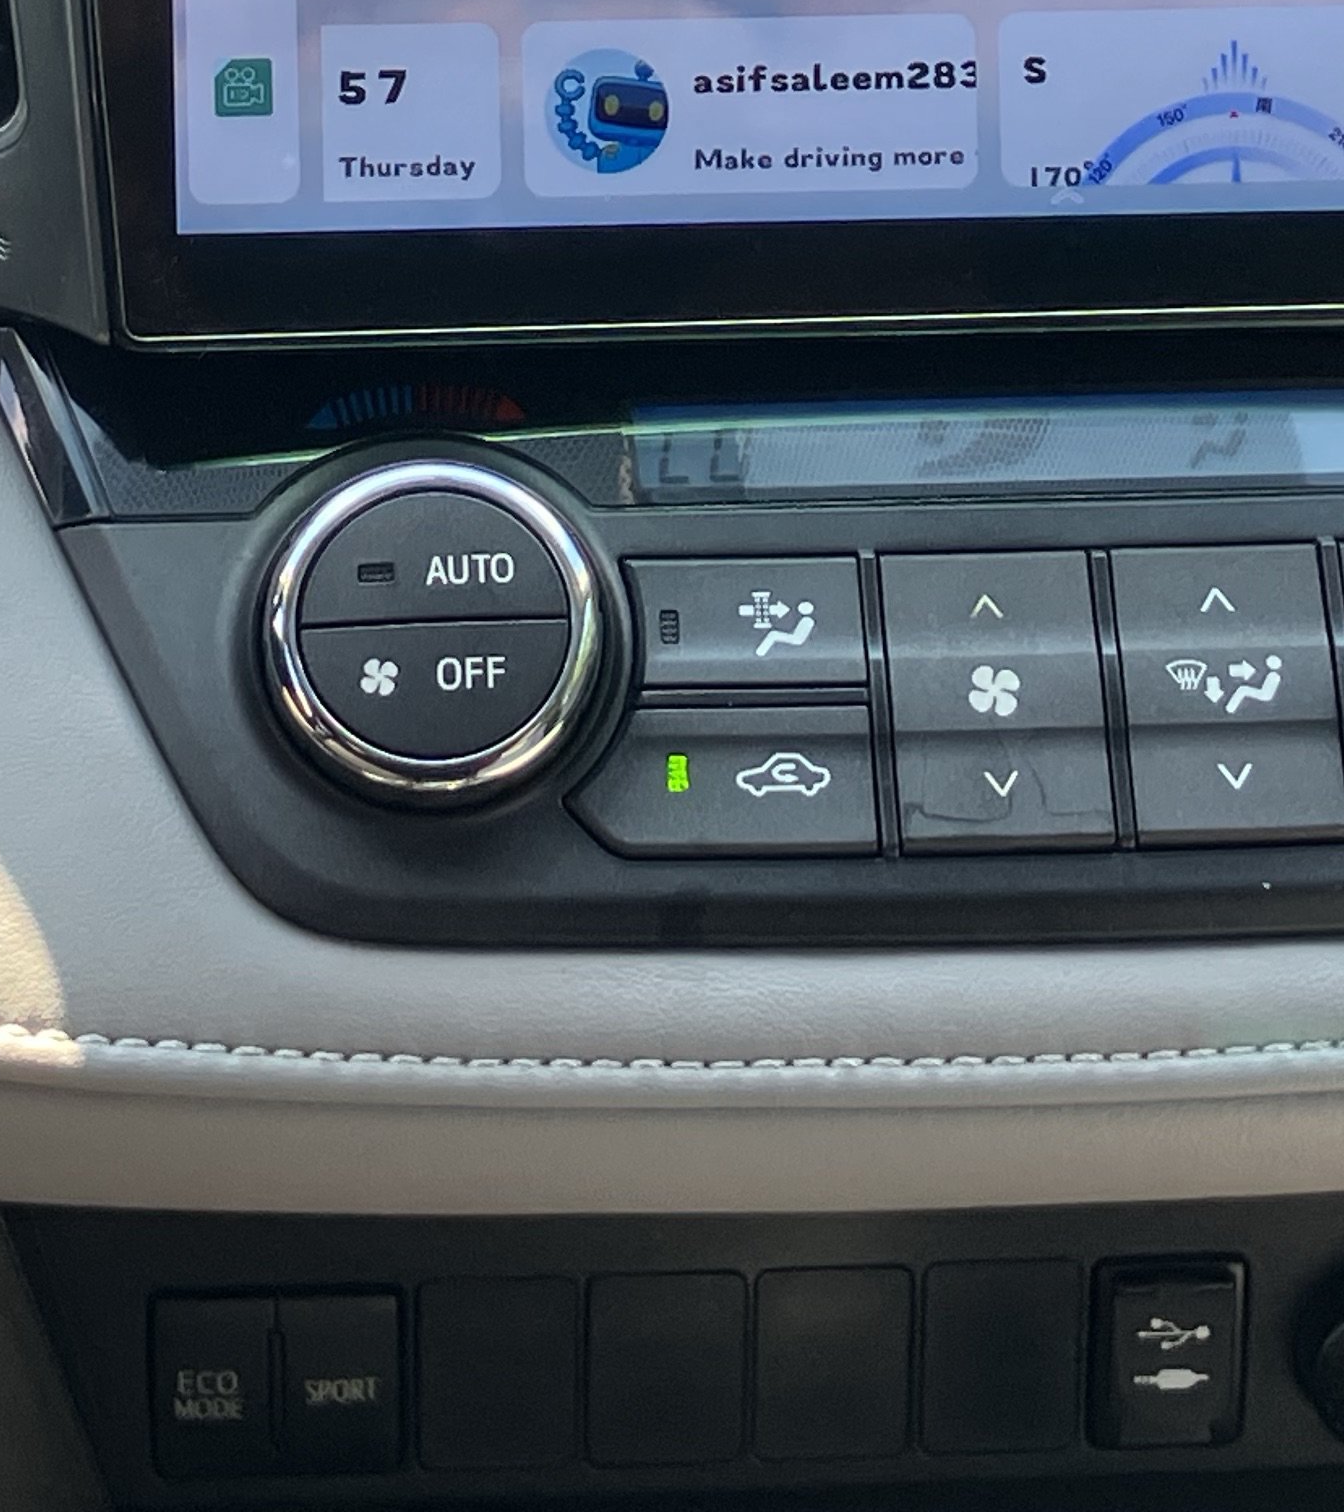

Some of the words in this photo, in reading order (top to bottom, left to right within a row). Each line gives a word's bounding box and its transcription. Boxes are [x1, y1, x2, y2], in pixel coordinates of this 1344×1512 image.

[1023, 56, 1047, 85] S
[338, 155, 477, 181] Thursday
[694, 147, 773, 172] Make
[784, 146, 883, 172] driving
[894, 147, 966, 167] more
[425, 554, 516, 586] AUTO
[435, 657, 506, 690] OFF
[176, 1369, 239, 1396] ECO
[305, 1376, 377, 1405] SPORT
[173, 1397, 245, 1420] MODE
